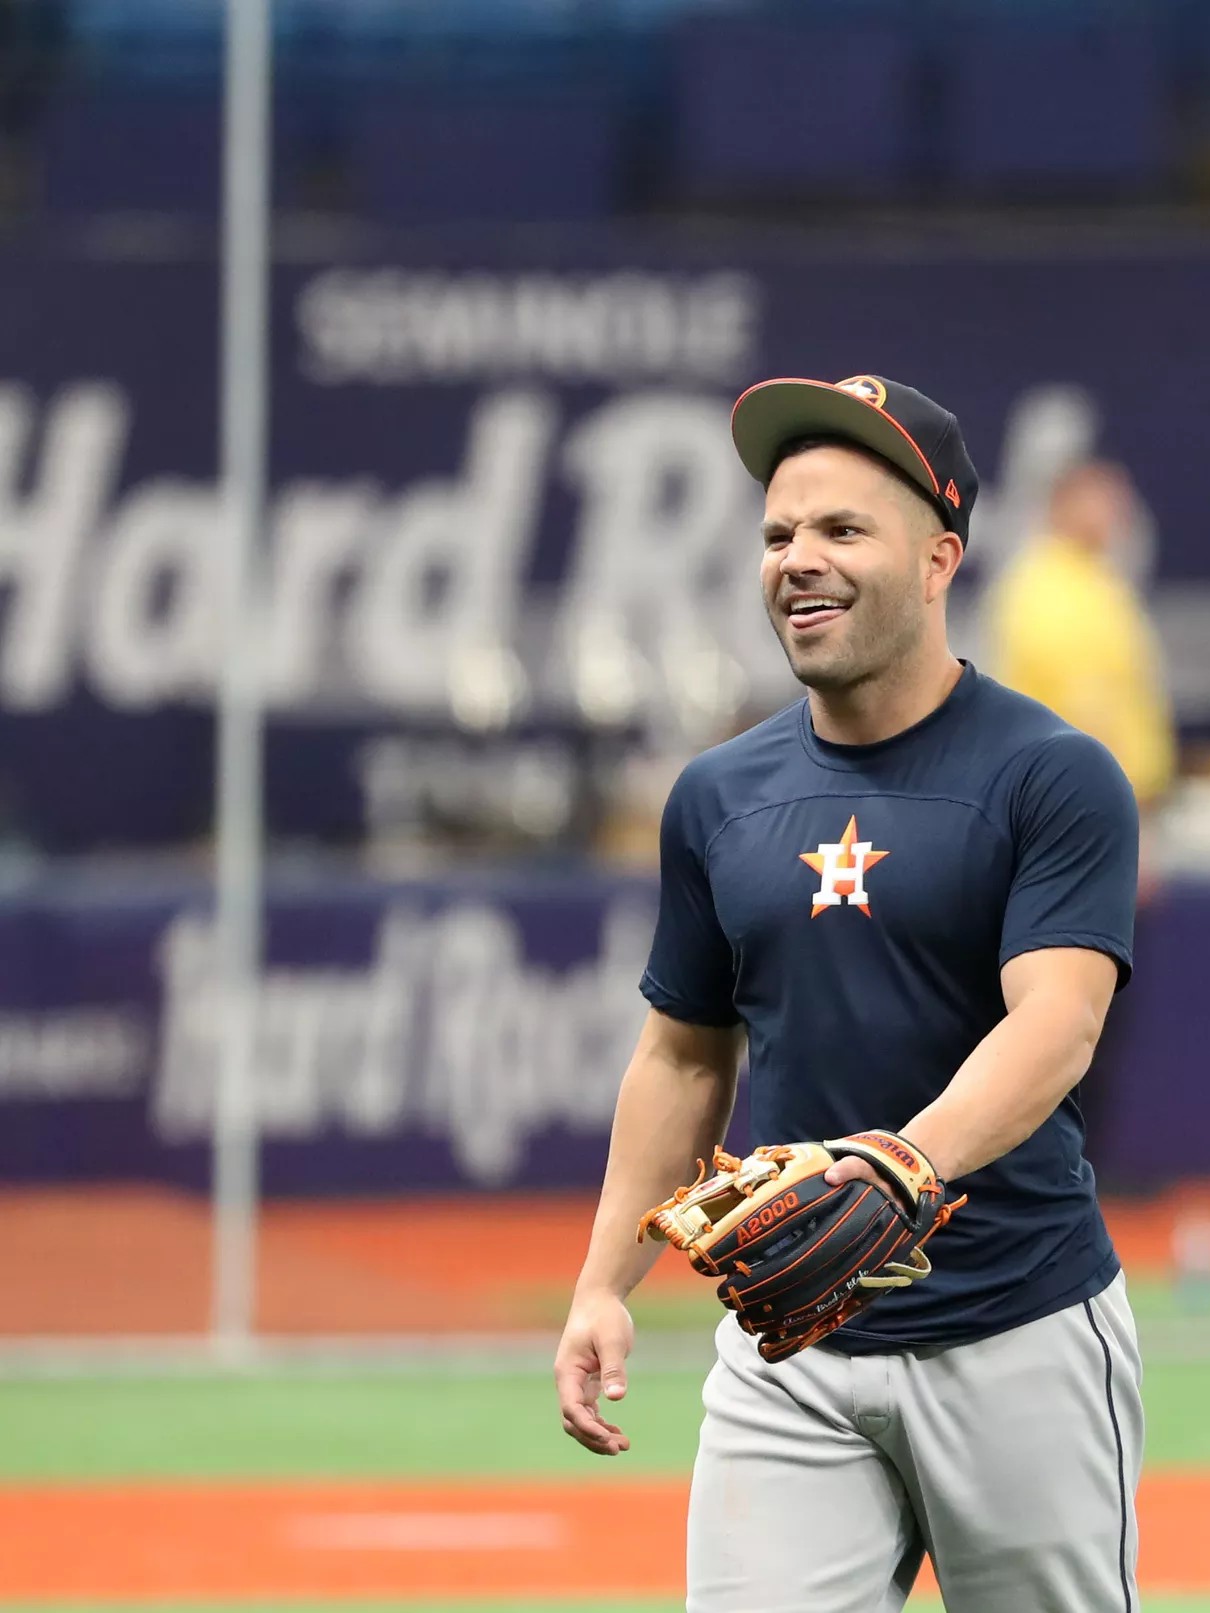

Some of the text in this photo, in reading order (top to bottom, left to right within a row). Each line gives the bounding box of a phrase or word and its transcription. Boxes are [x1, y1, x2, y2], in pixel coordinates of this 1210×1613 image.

[303, 273, 754, 382] SEMINOLE
[812, 841, 873, 906] H
[736, 1191, 799, 1246] A2000
